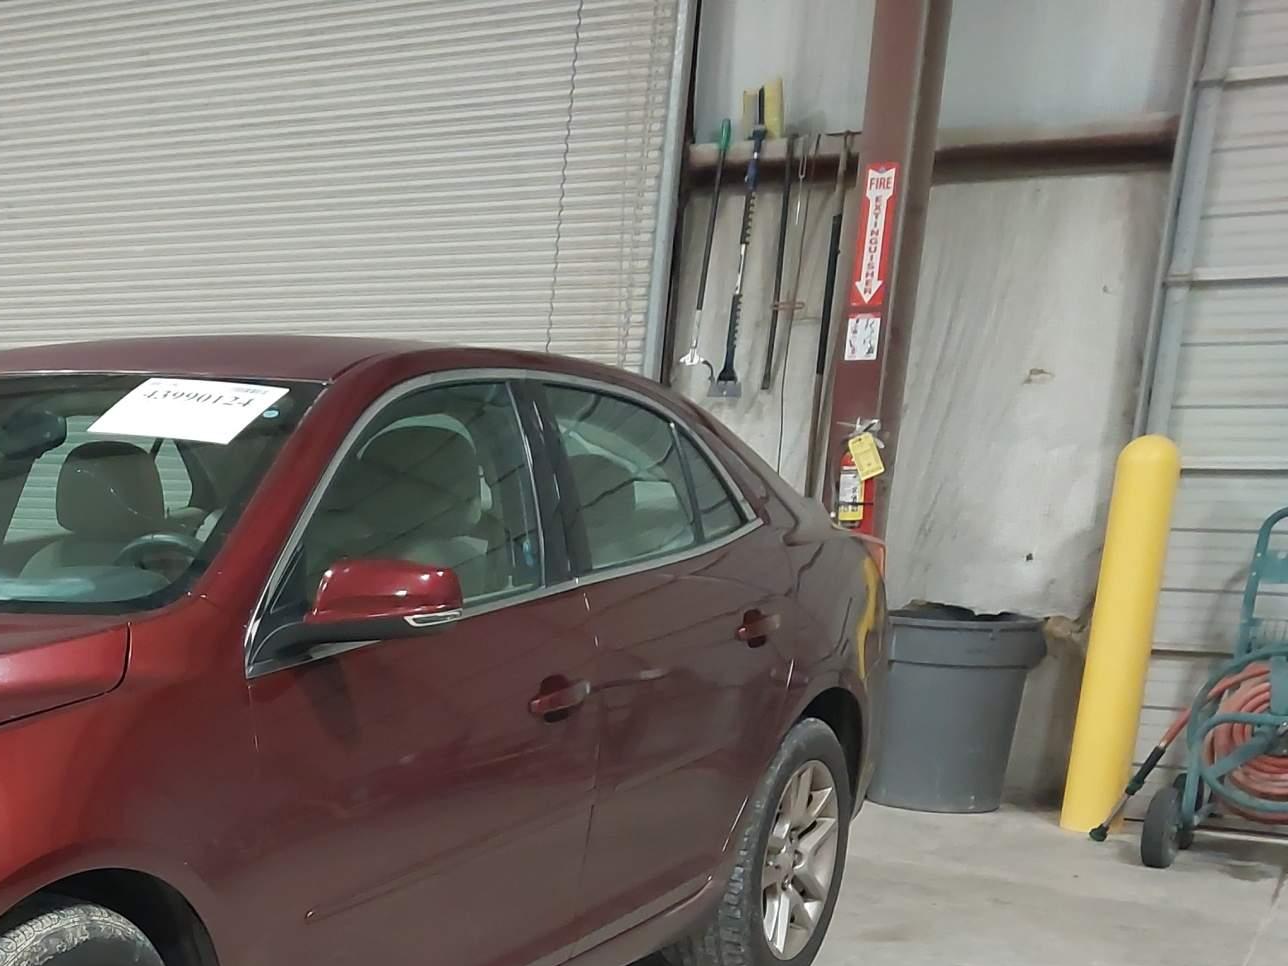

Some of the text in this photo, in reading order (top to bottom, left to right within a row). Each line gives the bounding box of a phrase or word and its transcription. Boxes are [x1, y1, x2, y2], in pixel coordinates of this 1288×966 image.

[869, 177, 893, 191] FIRE
[864, 195, 883, 295] EXTINGUISHER
[143, 389, 255, 407] 43990124
